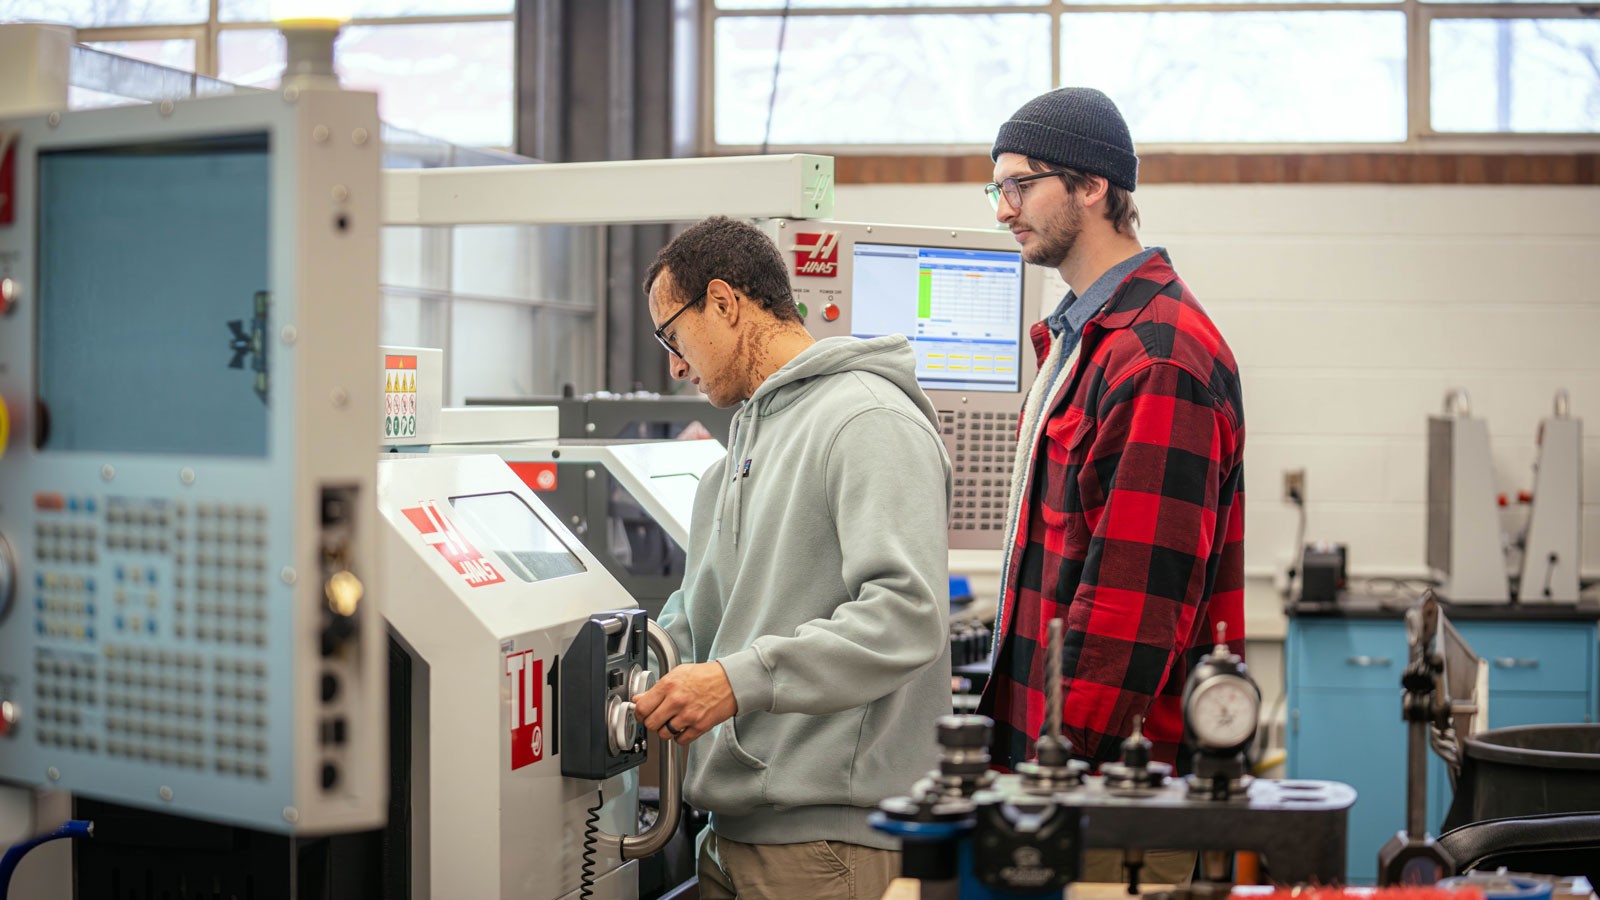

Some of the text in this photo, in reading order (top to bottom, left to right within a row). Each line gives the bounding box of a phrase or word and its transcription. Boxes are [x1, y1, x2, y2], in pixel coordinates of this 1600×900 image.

[797, 261, 837, 274] HAAS
[459, 559, 499, 584] HAAS
[506, 650, 559, 756] TL 1
